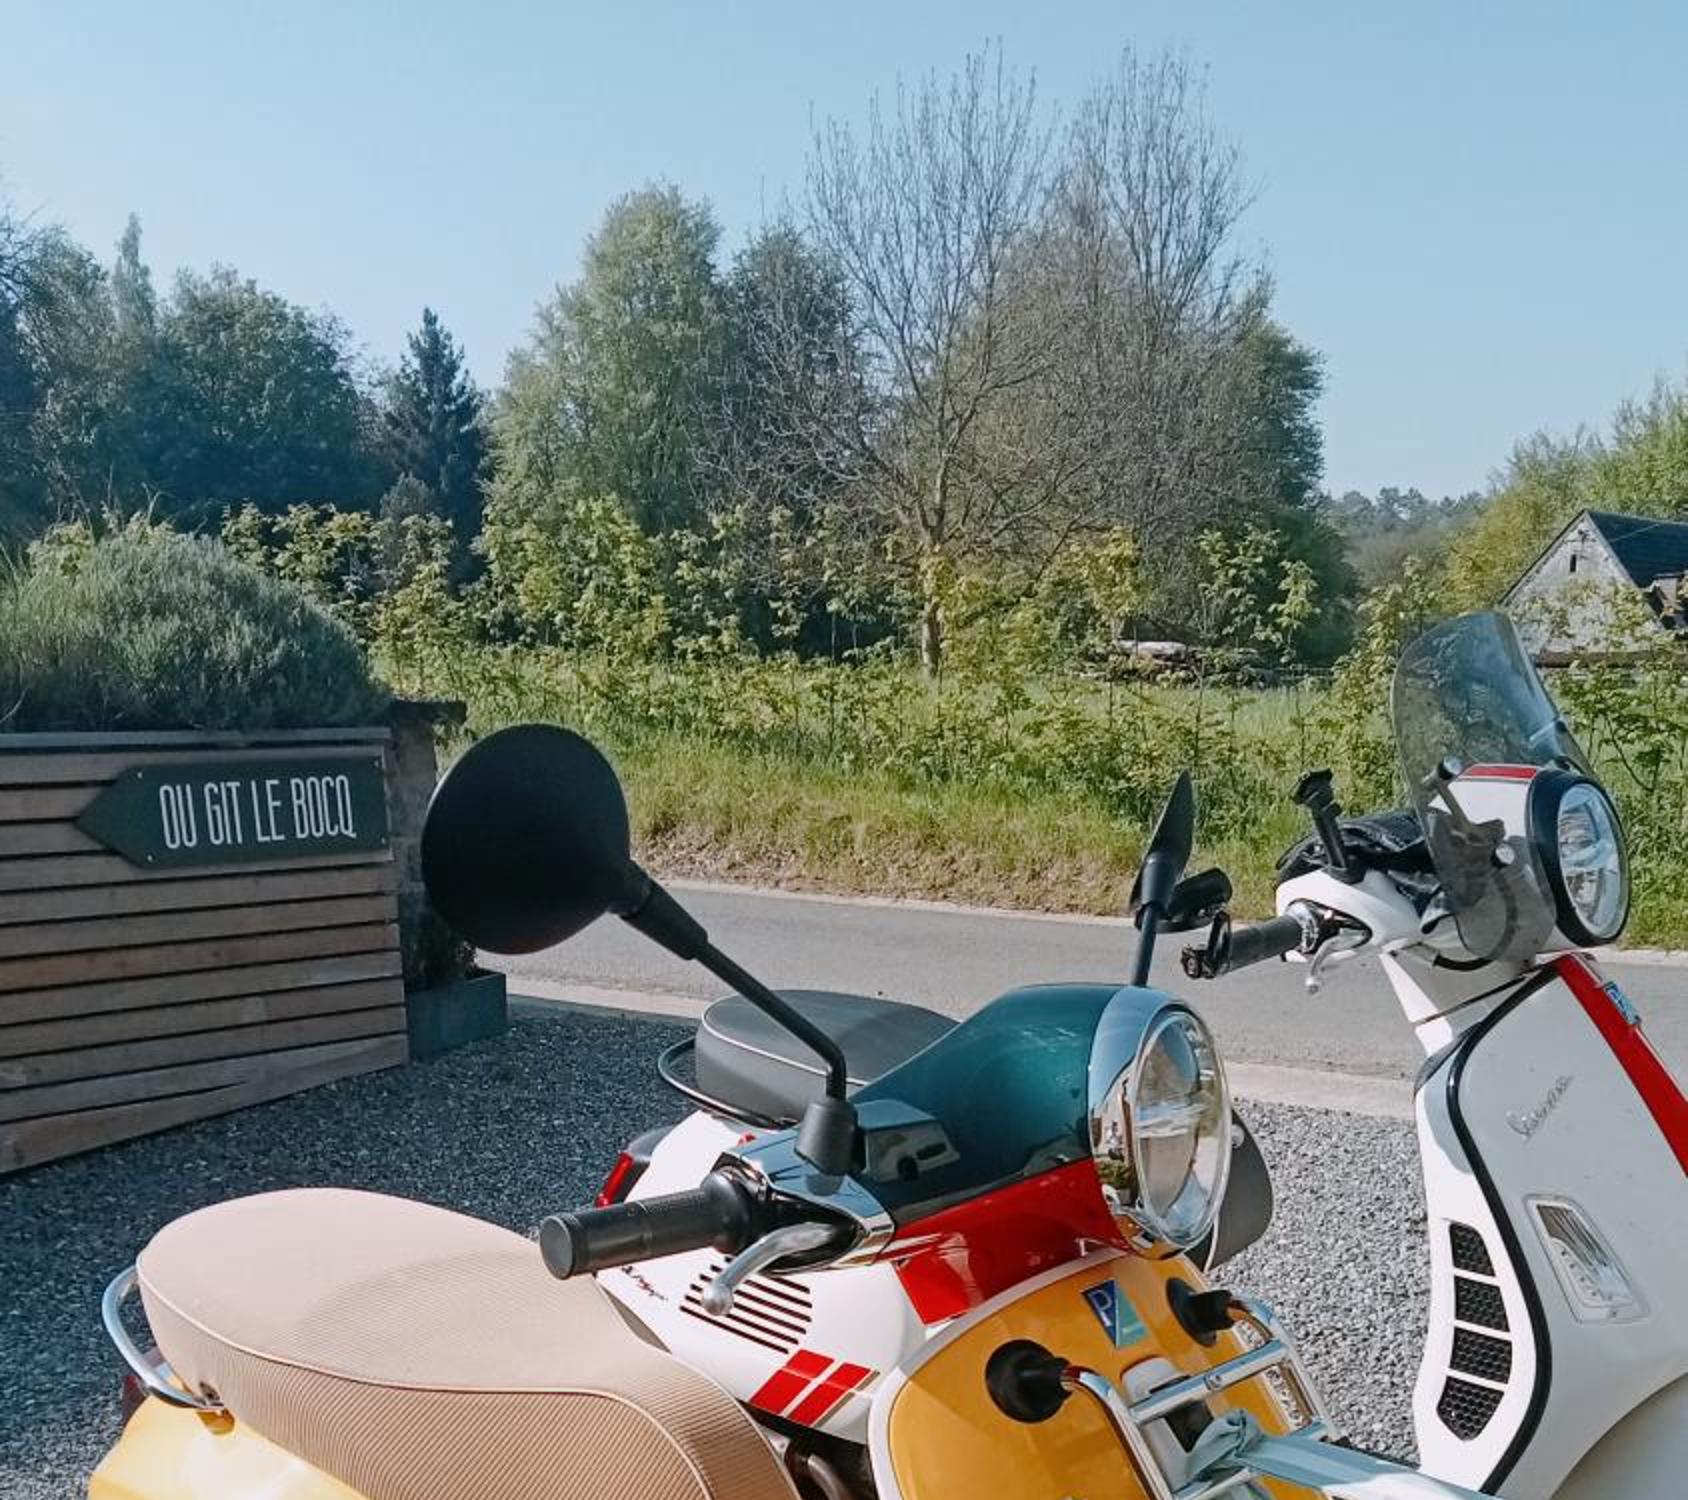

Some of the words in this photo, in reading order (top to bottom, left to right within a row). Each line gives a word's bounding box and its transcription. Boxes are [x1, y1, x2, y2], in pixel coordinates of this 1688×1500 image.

[159, 783, 198, 849] OU
[203, 780, 243, 846] GIT
[250, 778, 286, 843] LE
[290, 774, 357, 840] BOCQ
